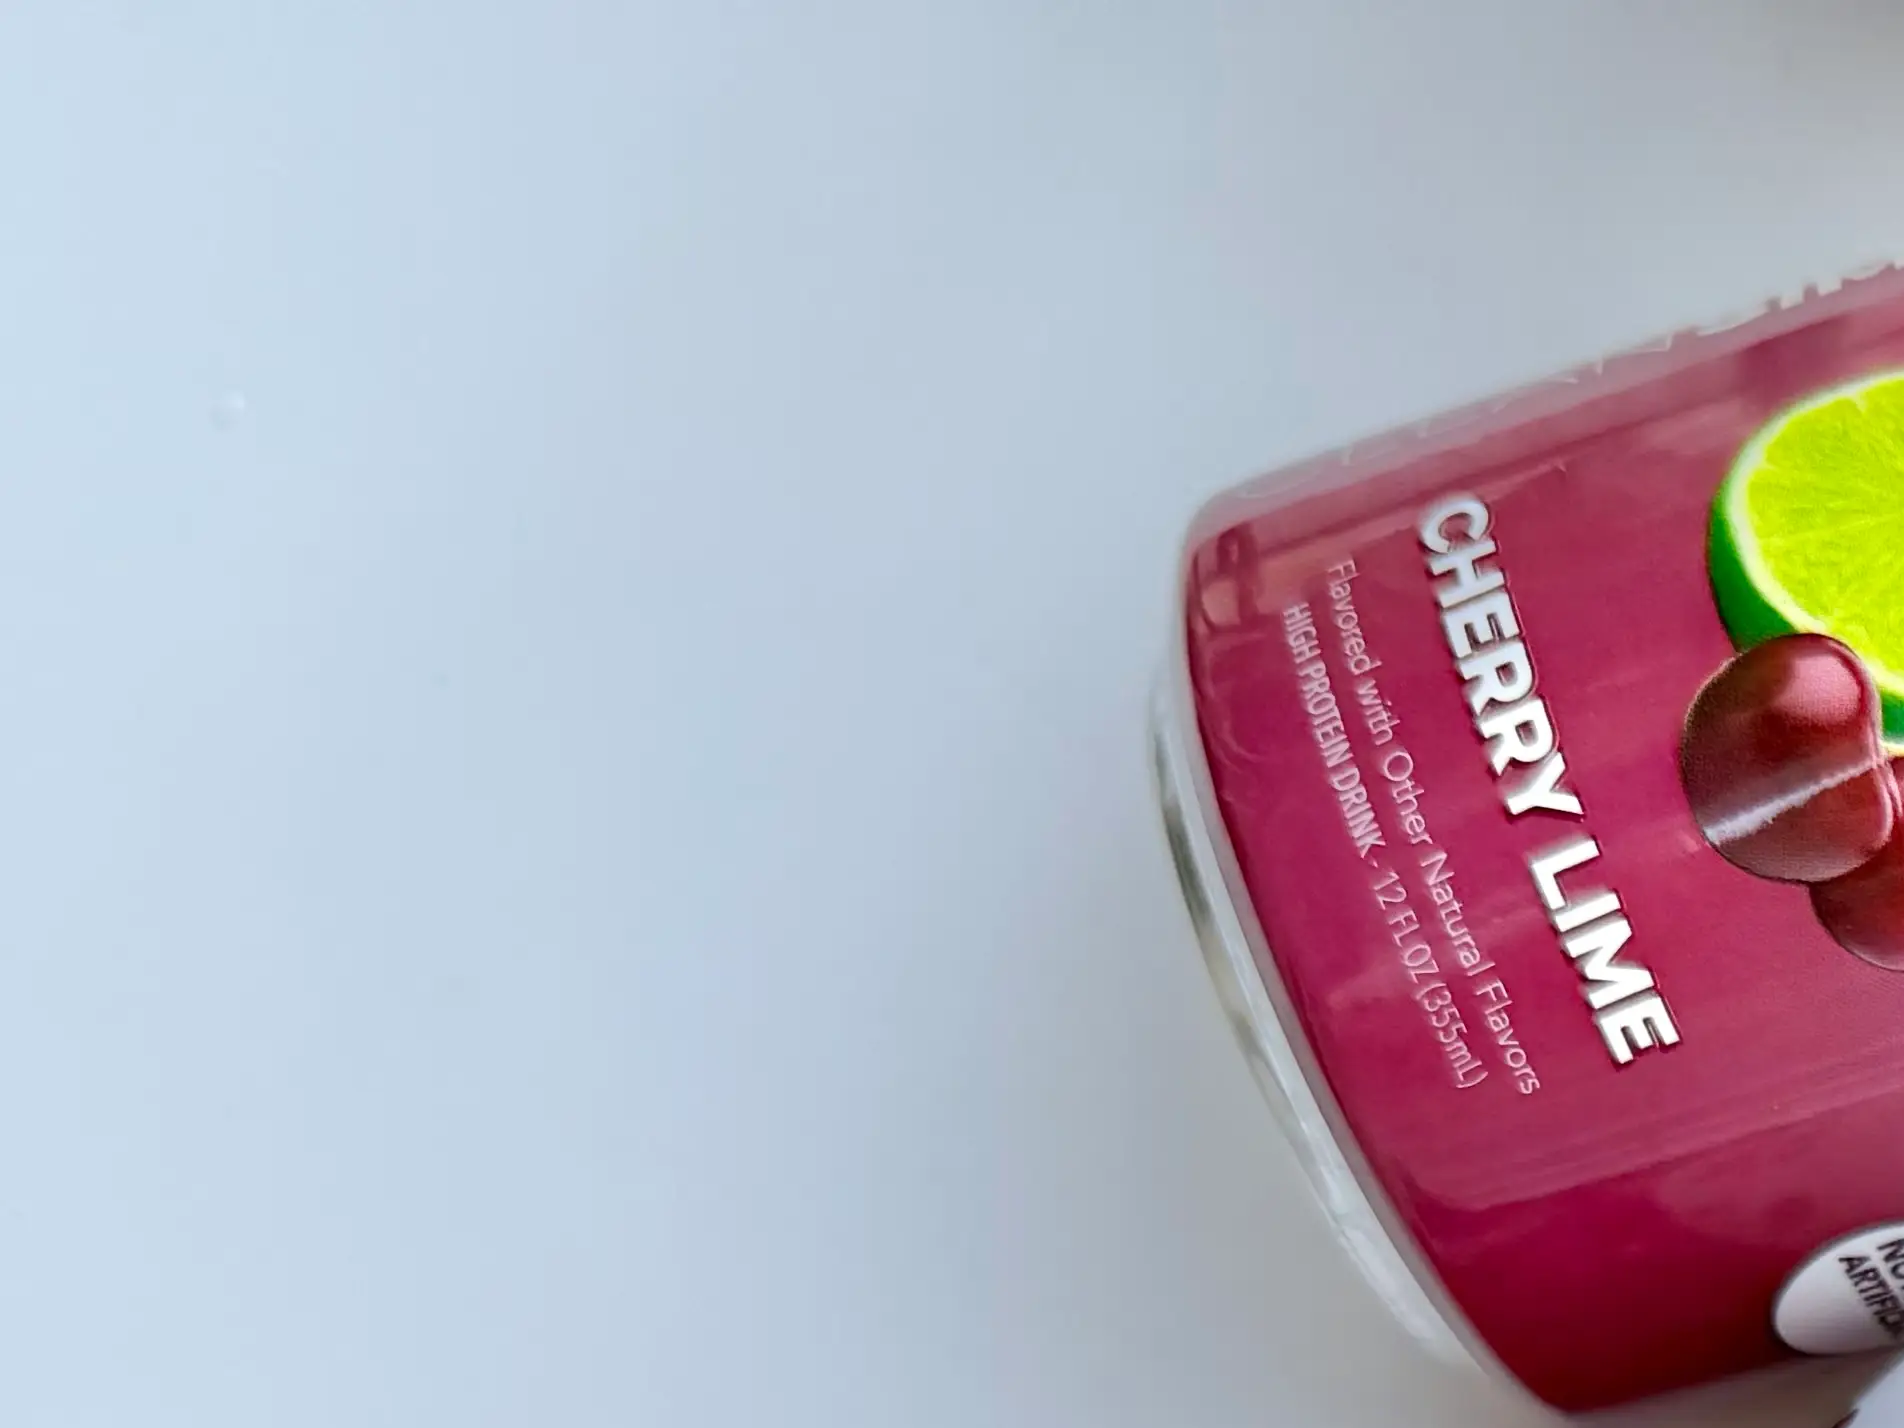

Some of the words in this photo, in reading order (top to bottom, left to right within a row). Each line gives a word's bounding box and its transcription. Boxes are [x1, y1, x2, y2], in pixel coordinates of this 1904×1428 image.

[1282, 602, 1319, 665] HIGH
[1300, 662, 1350, 768] PROTEIN
[1327, 559, 1382, 676] Flavored
[1355, 678, 1401, 748] with
[1380, 750, 1435, 845] Other
[1420, 852, 1495, 978] Natural
[1473, 978, 1541, 1096] Flavors
[1331, 763, 1387, 860] DRINK
[1419, 494, 1586, 818] CHERRY
[1528, 838, 1683, 1064] LIME
[1373, 868, 1408, 910] 12
[1387, 909, 1420, 947] FL
[1400, 943, 1440, 984] OZ
[1415, 982, 1489, 1090] (355mL)
